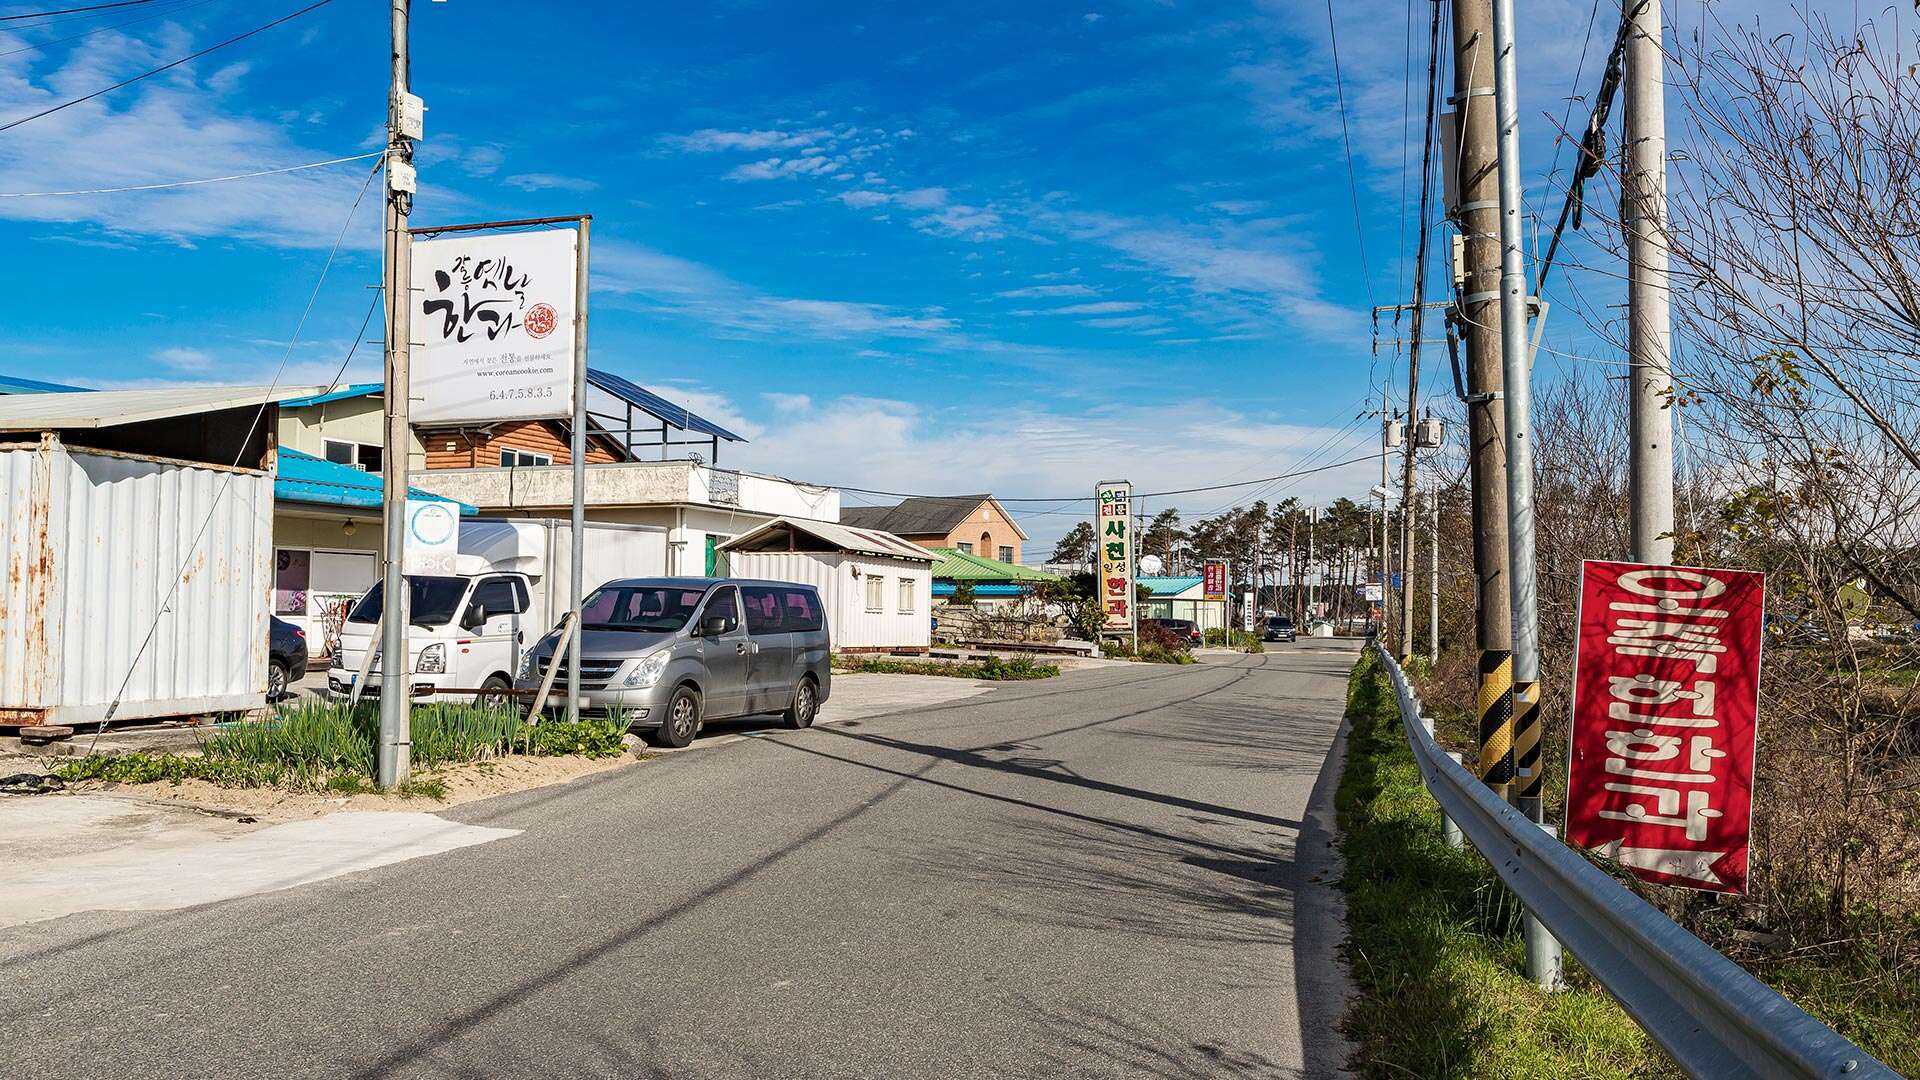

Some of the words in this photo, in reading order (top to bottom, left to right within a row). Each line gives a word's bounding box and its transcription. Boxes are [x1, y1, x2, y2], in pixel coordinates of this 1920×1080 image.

[452, 254, 472, 291] 강릉
[474, 256, 533, 310] 옛날
[423, 270, 523, 343] 한과
[477, 367, 554, 377] www.coreancookie.com
[490, 386, 553, 400] 6.4.7.5.8.3.5
[1105, 520, 1126, 561] 사천
[1107, 577, 1128, 618] 한과
